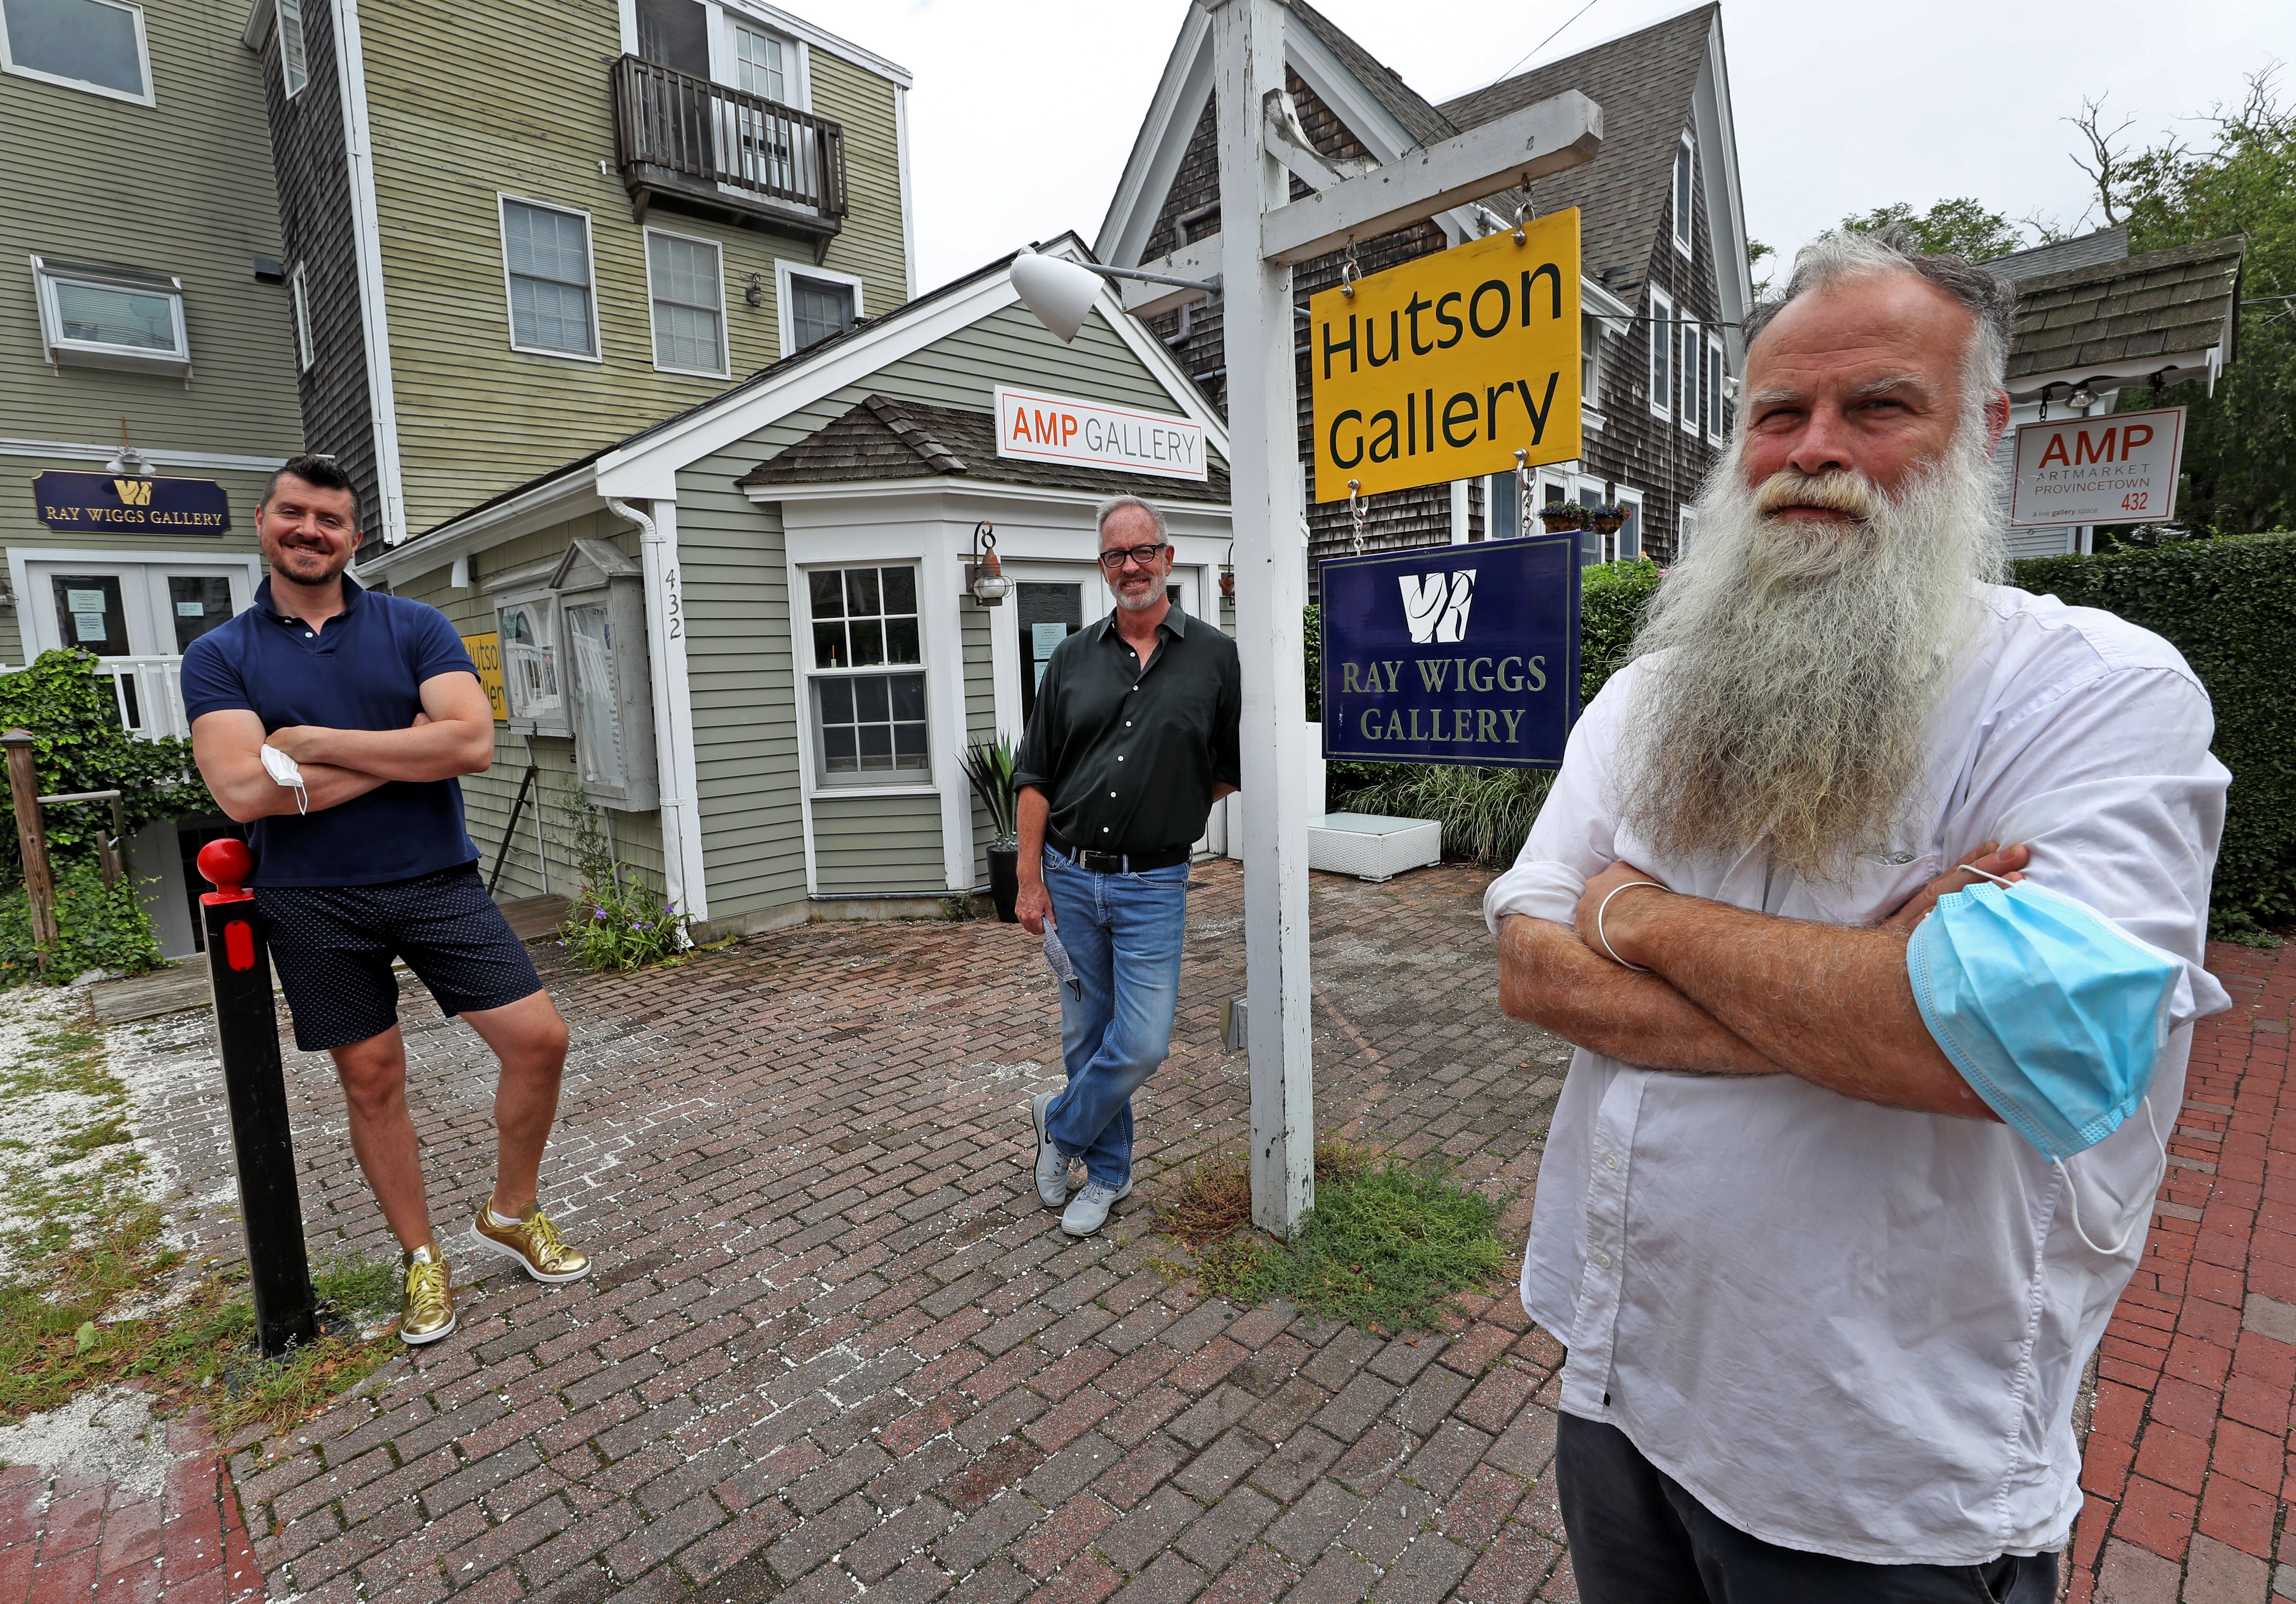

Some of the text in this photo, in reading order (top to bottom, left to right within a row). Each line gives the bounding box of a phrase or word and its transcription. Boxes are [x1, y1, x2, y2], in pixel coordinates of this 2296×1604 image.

[1323, 263, 1561, 380] Hutson
[1013, 407, 1195, 464] AMP GALLERY
[1329, 372, 1559, 469] Gallery
[2038, 424, 2154, 469] AMP
[2035, 477, 2150, 495] PROVINCETOWN
[2121, 492, 2148, 511] 432
[45, 507, 222, 526] RAY WIGGS GALLERY
[2052, 508, 2076, 517] gallery
[2077, 507, 2098, 516] space
[1342, 656, 1546, 693] RAY WIGGS
[1360, 708, 1526, 743] GALLERY
